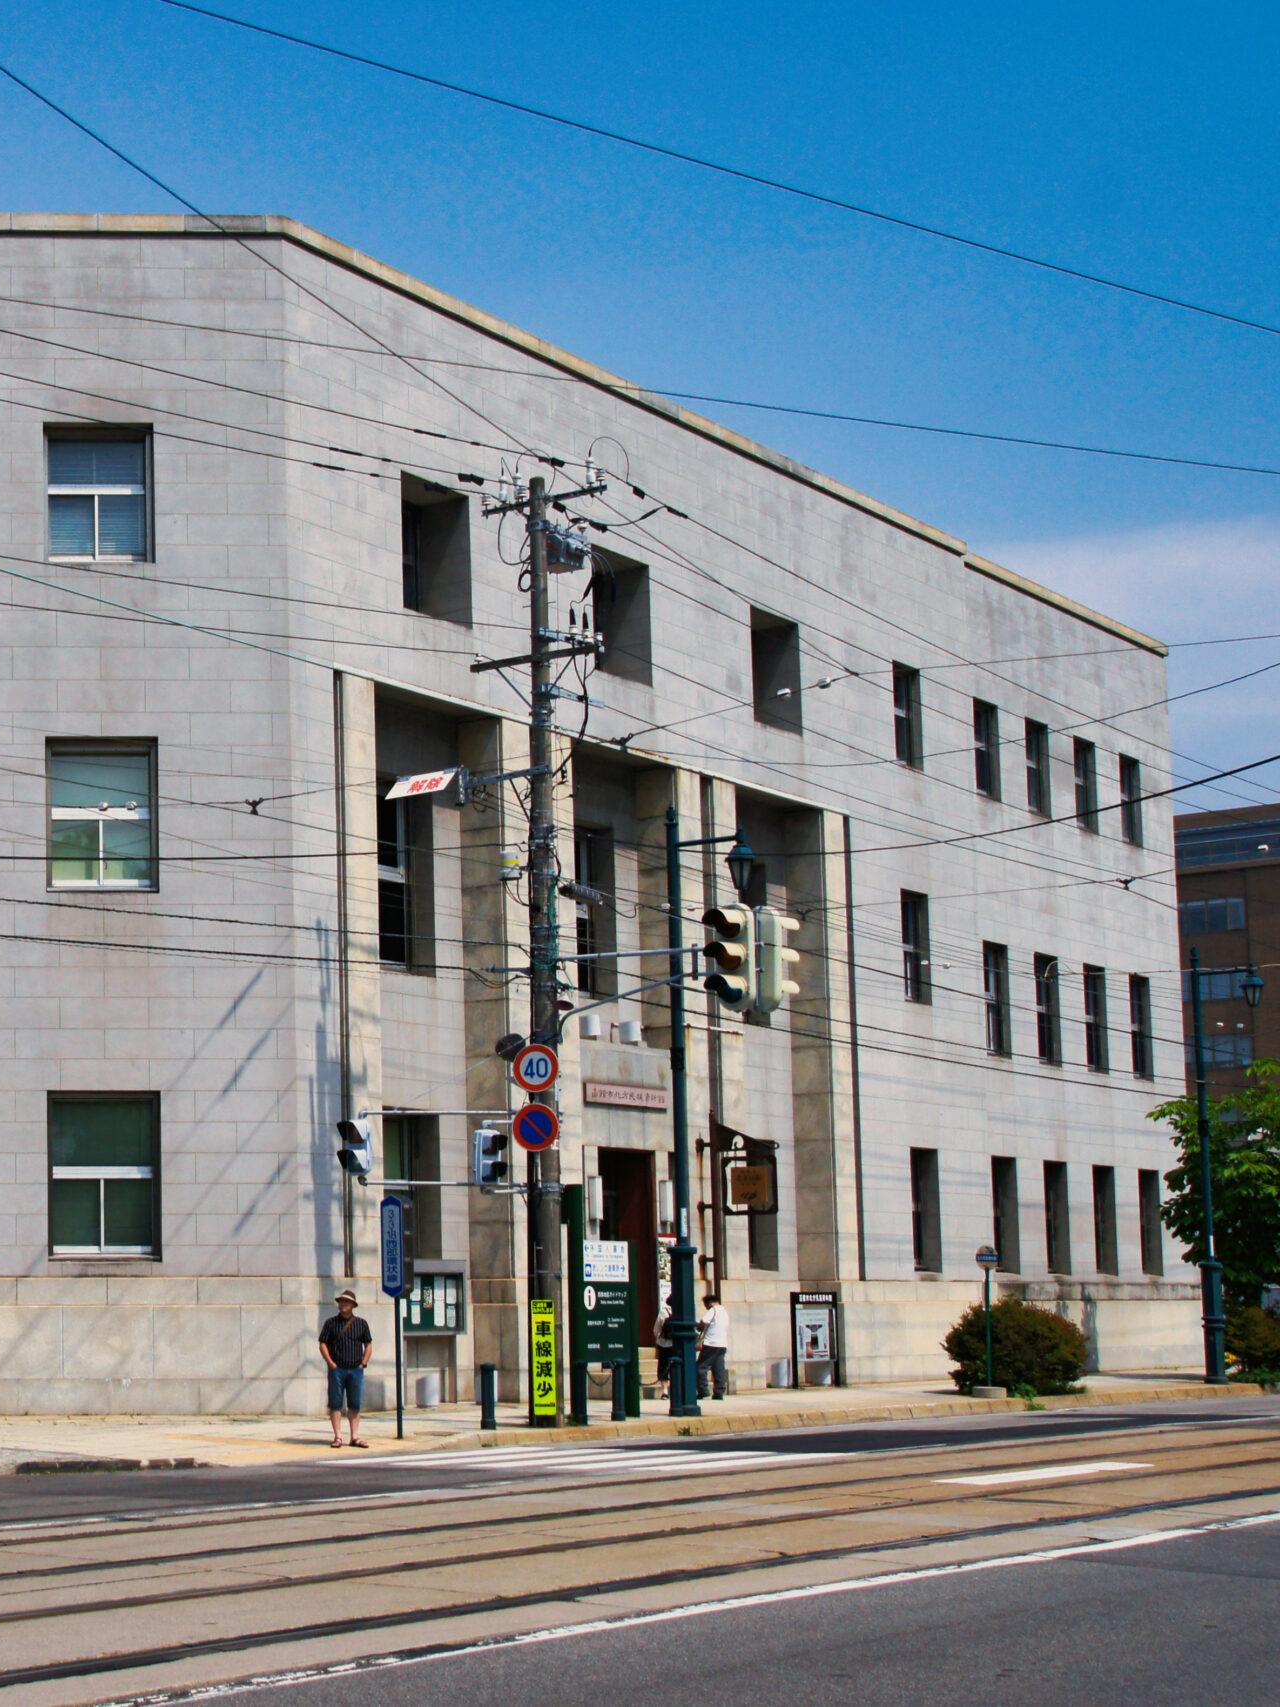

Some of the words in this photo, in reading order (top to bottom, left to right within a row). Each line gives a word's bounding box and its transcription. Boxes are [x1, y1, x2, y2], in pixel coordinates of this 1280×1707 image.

[524, 1058, 548, 1079] 40
[535, 1320, 554, 1398] 車線減少
